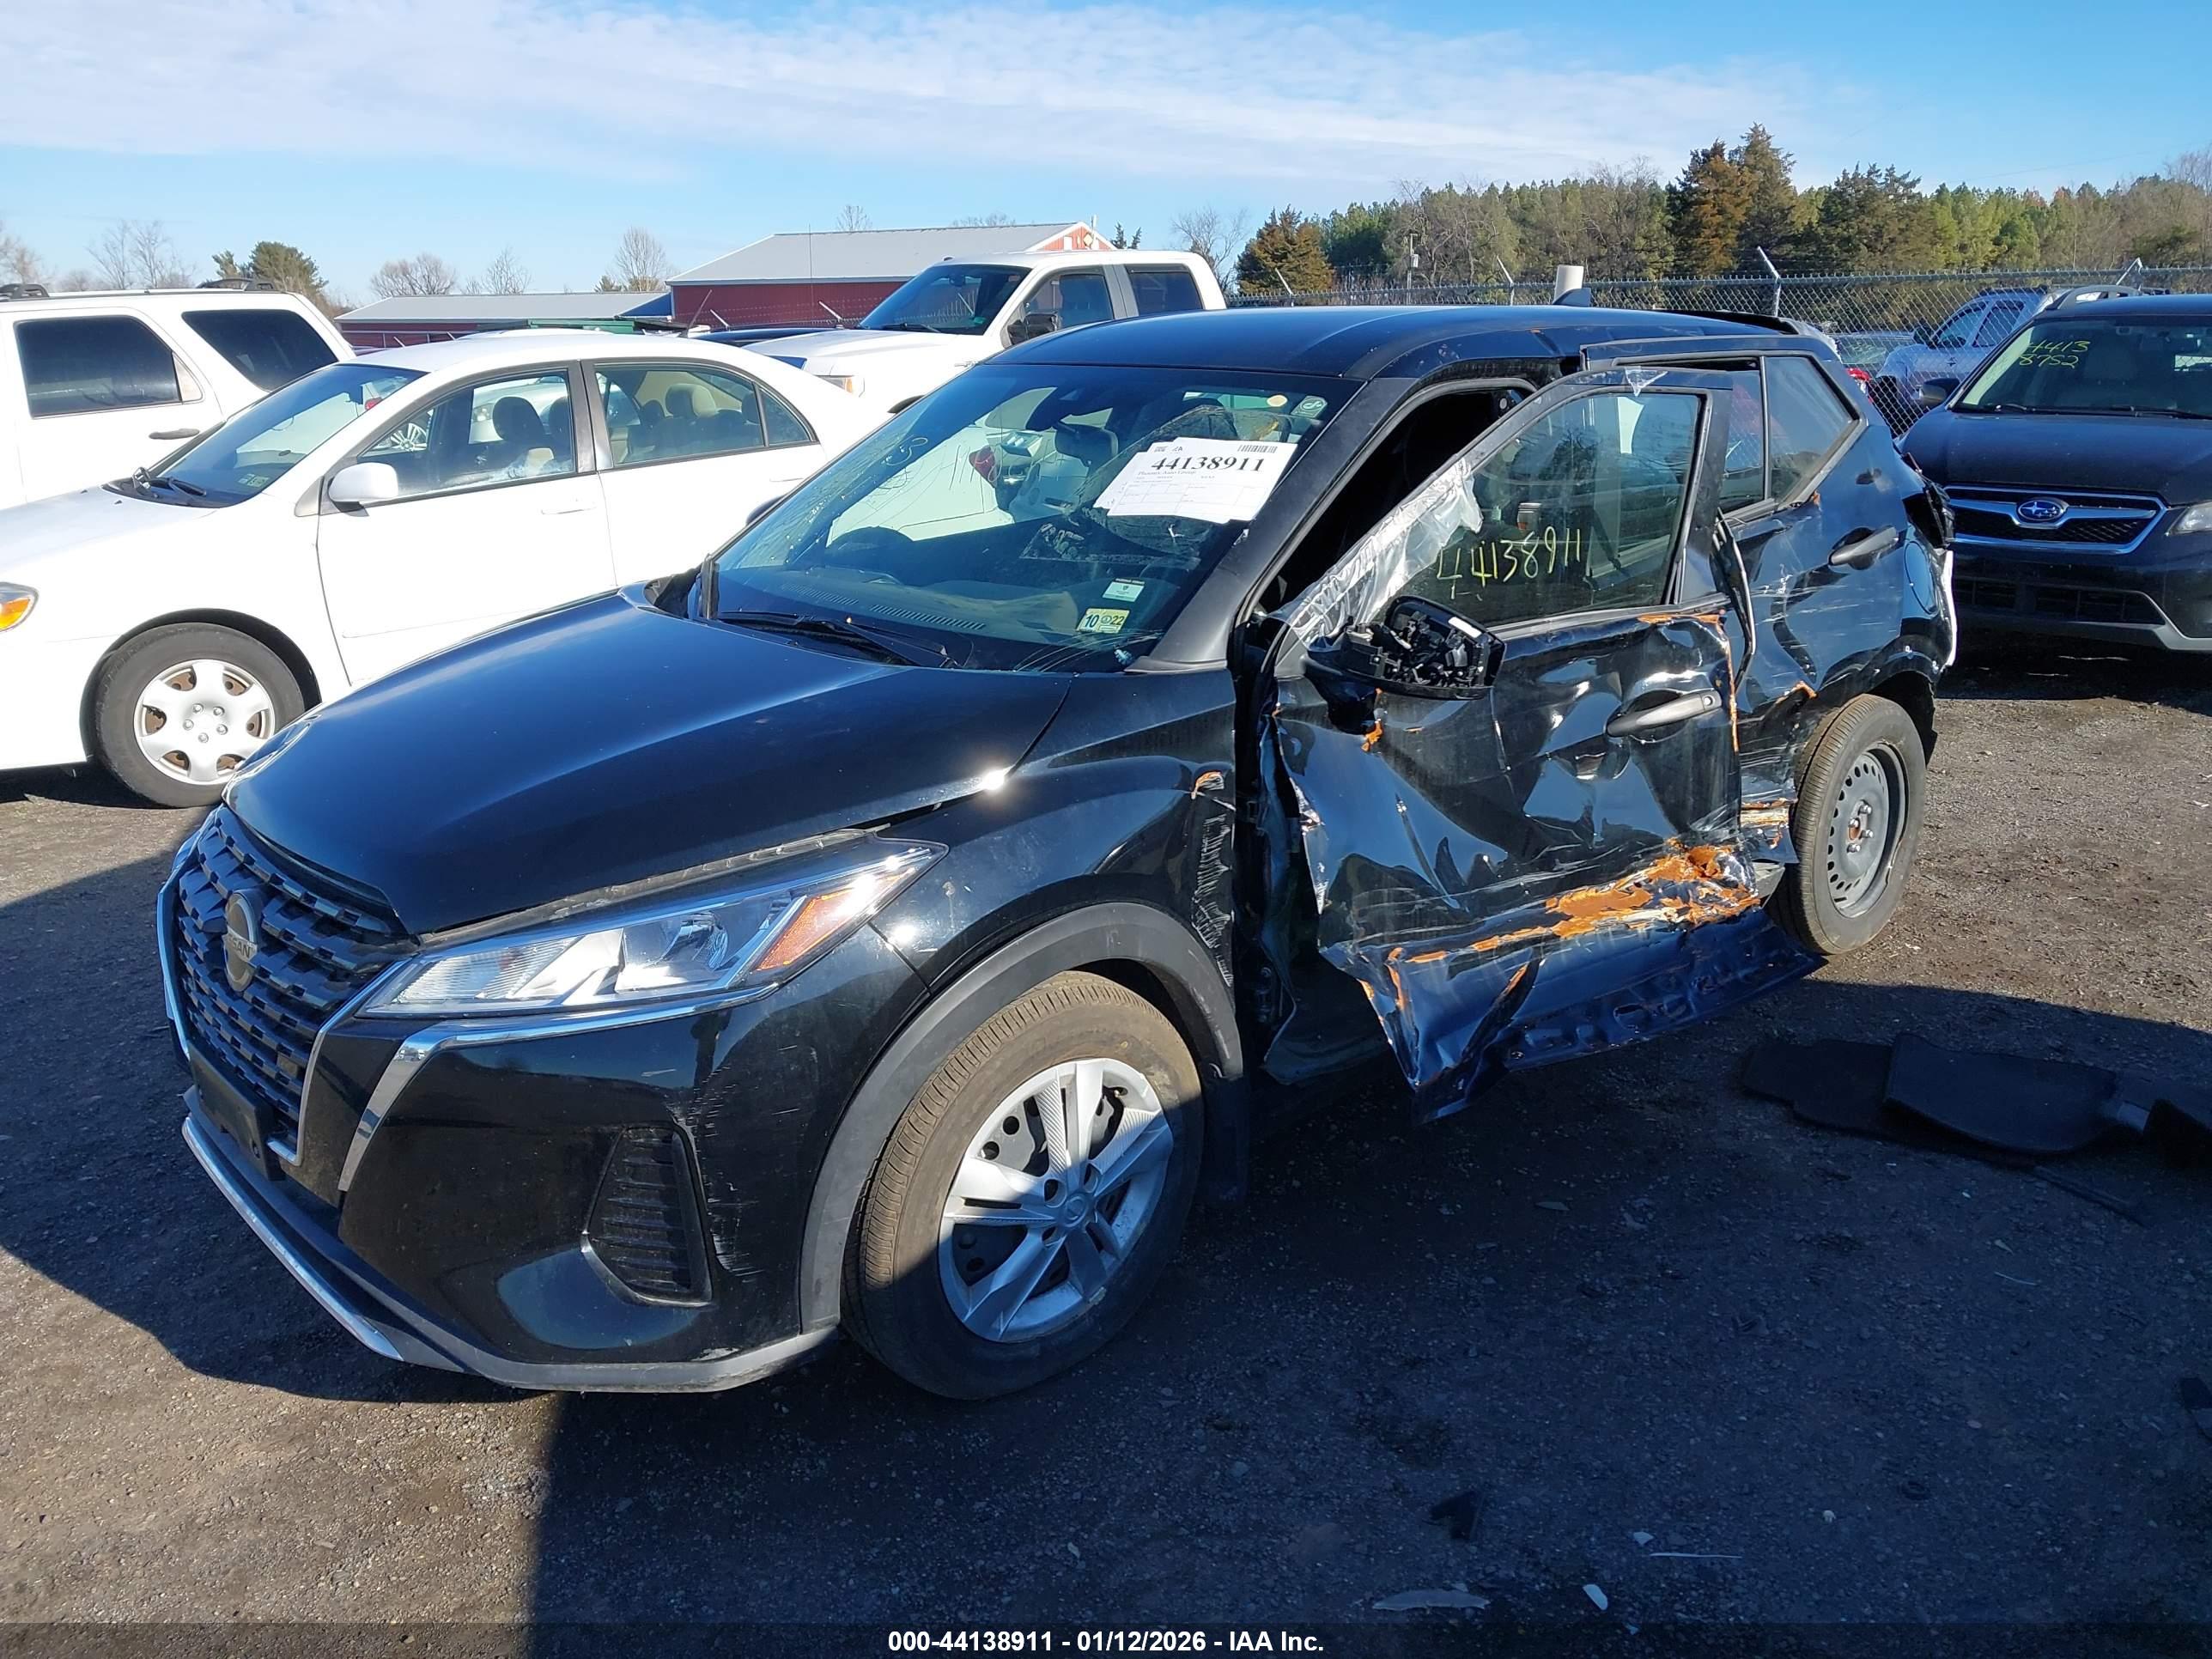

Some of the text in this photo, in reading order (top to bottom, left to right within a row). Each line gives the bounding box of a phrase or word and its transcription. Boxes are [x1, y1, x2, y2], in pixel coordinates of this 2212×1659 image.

[1151, 456, 1265, 472] 44138911
[1437, 526, 1580, 599] 44138911
[1085, 614, 1125, 628] 10 22
